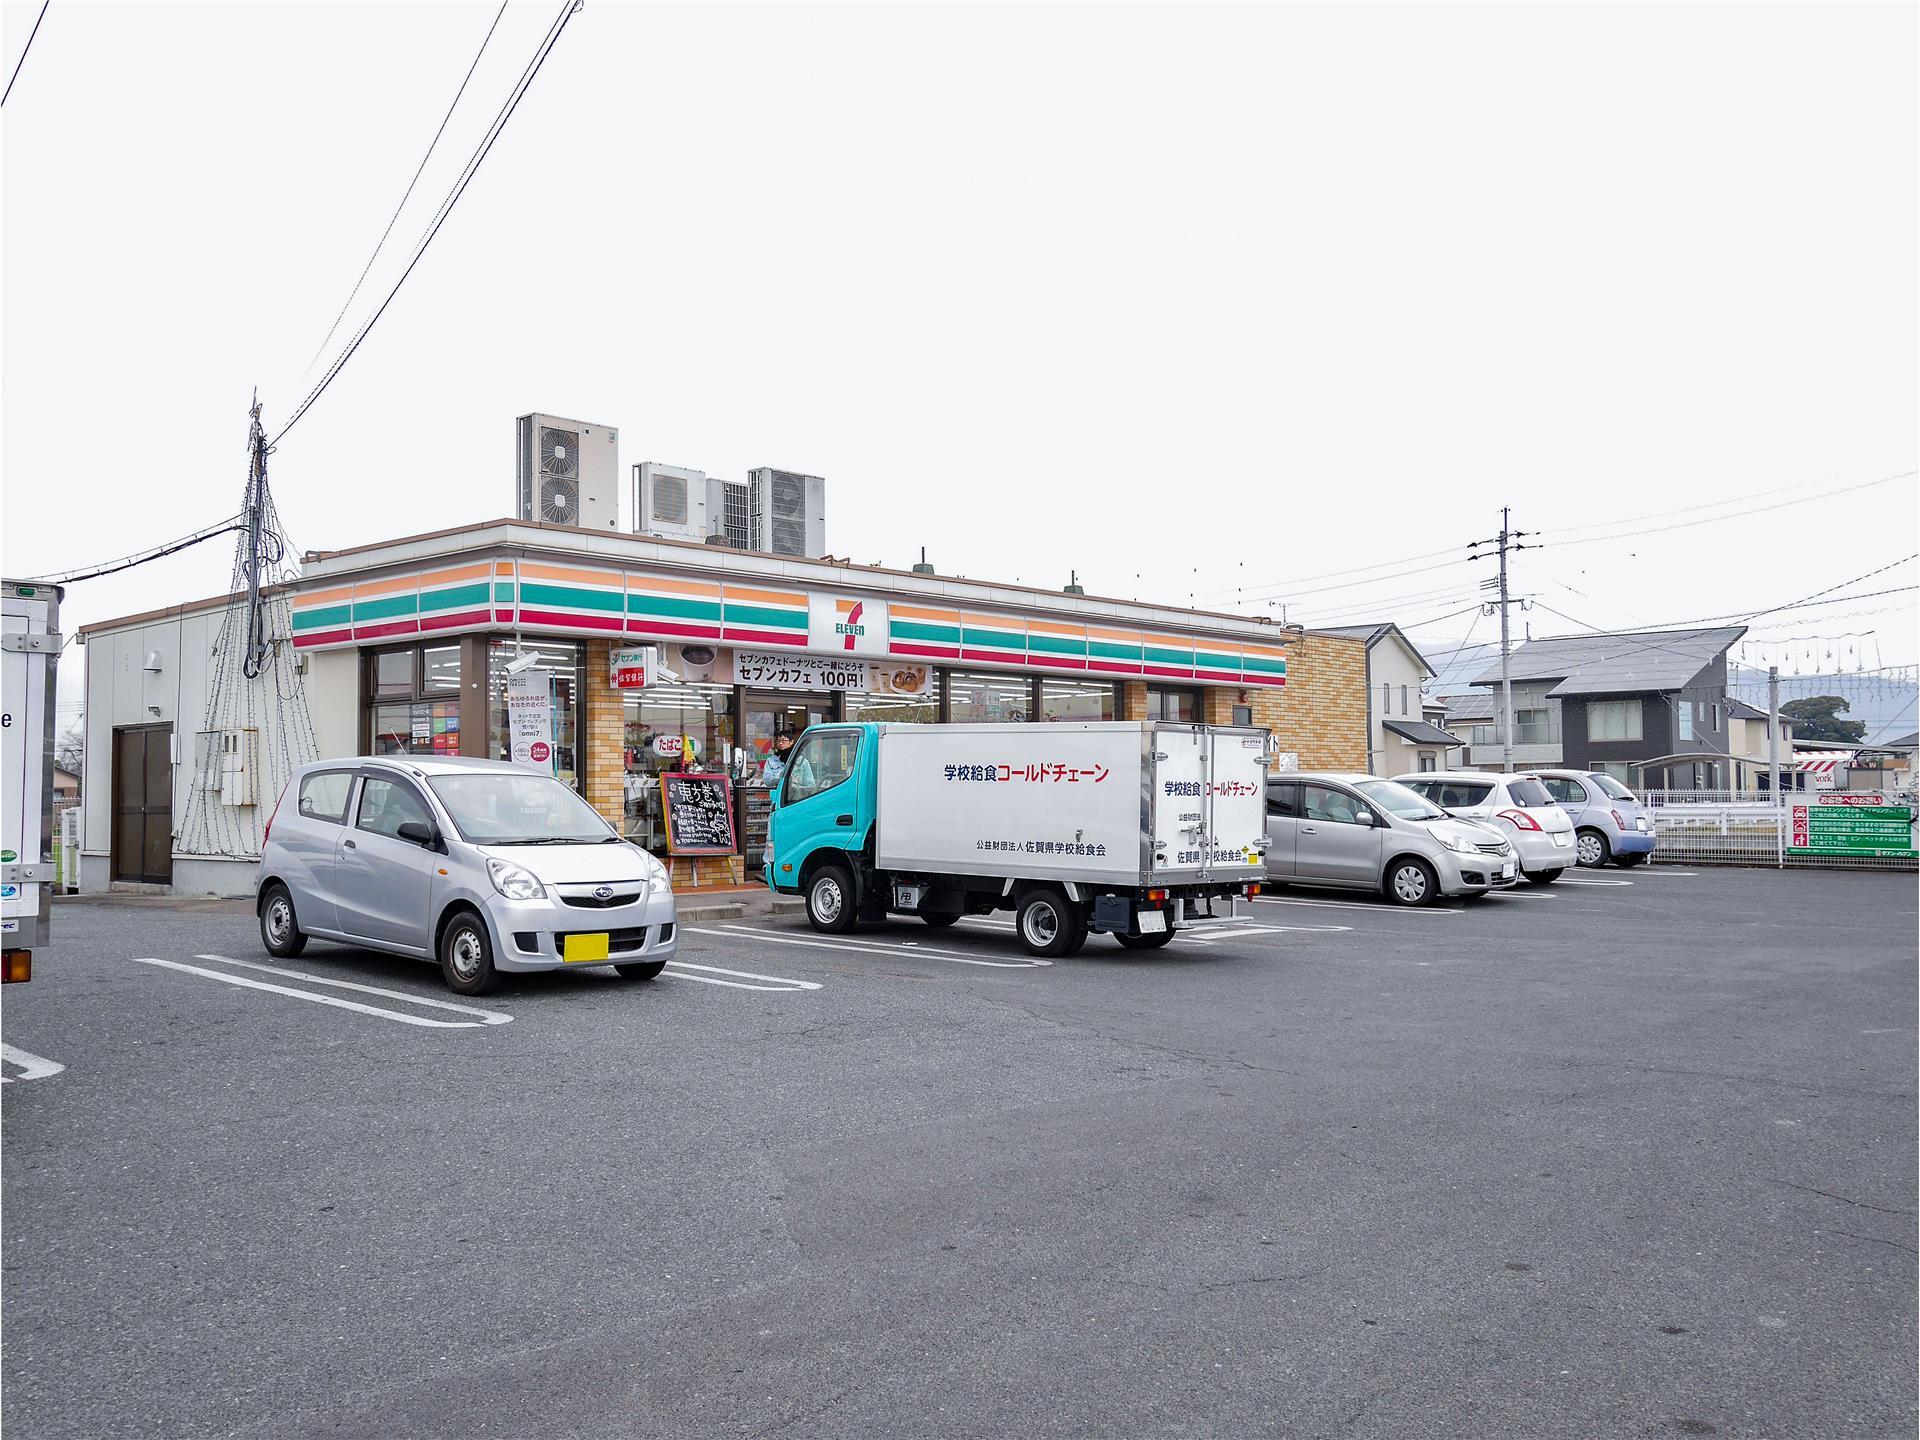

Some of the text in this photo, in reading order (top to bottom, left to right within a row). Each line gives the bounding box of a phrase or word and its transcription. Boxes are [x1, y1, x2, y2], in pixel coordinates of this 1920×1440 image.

[739, 654, 864, 673] セブンカフェドーナツとご一緒にどうぞ
[739, 665, 813, 684] セブンカフェ
[658, 738, 682, 752] たばこ
[944, 763, 1109, 783] 学校給食コールドチェーン
